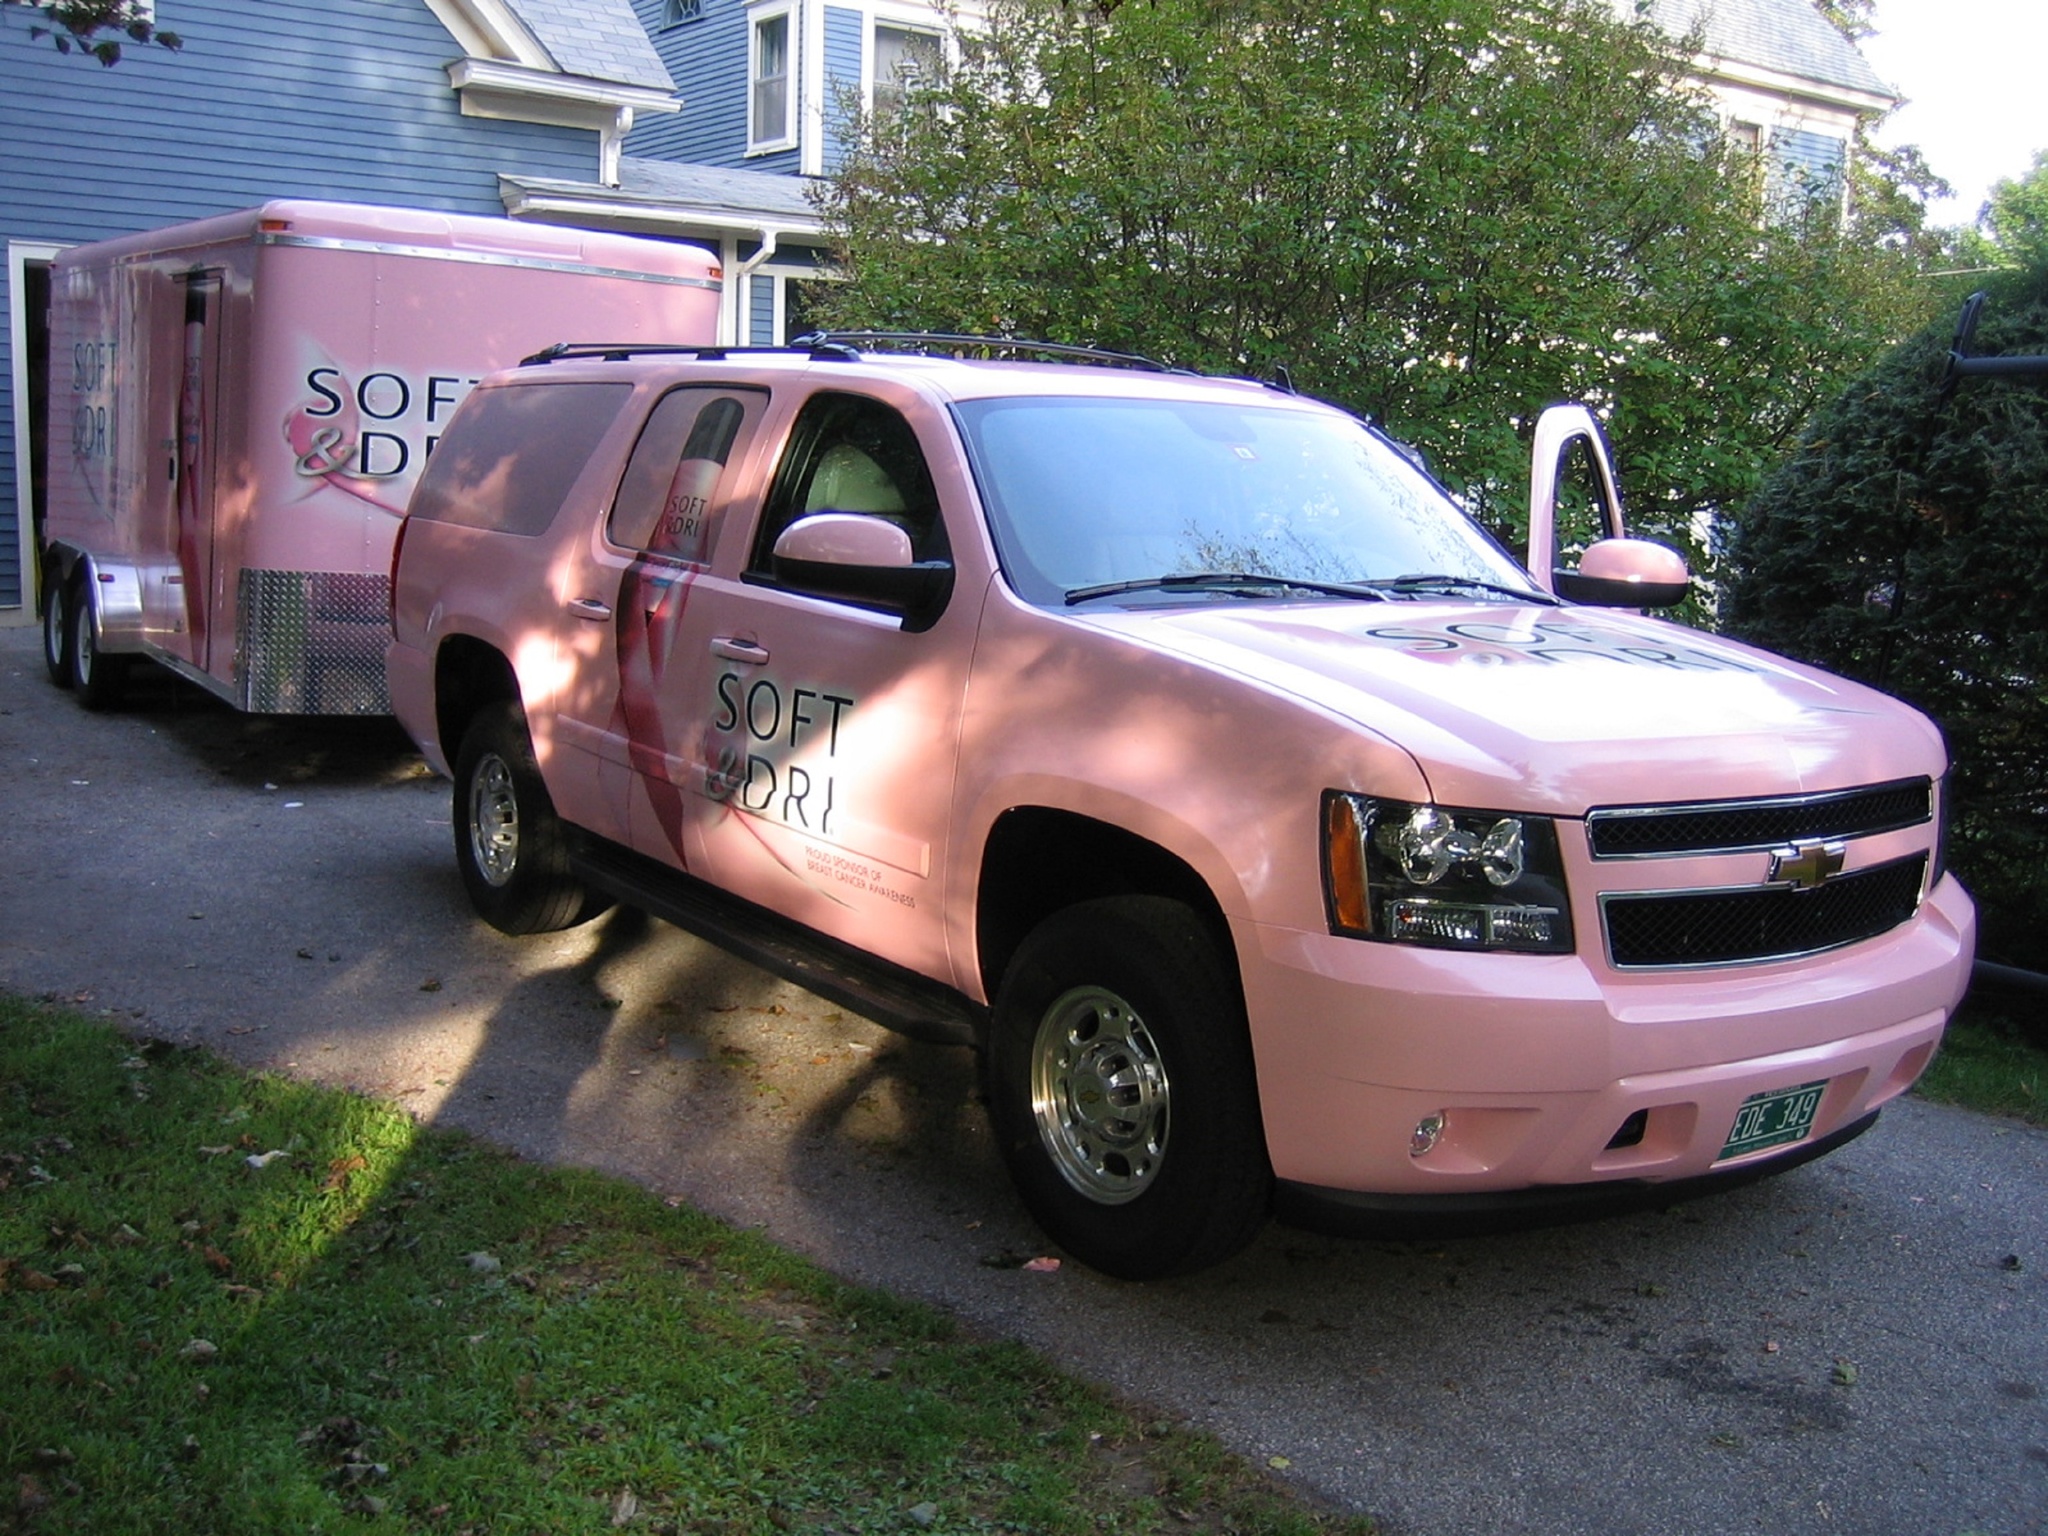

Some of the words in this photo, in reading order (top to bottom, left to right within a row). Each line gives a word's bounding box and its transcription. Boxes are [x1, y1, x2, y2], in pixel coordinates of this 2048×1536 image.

[73, 342, 117, 392] SOFT
[669, 495, 708, 517] SOFT
[716, 672, 855, 758] SOFT
[834, 870, 867, 890] CANCER
[870, 869, 882, 882] OF
[1728, 1102, 1773, 1143] EDE
[1775, 1092, 1817, 1130] 349
